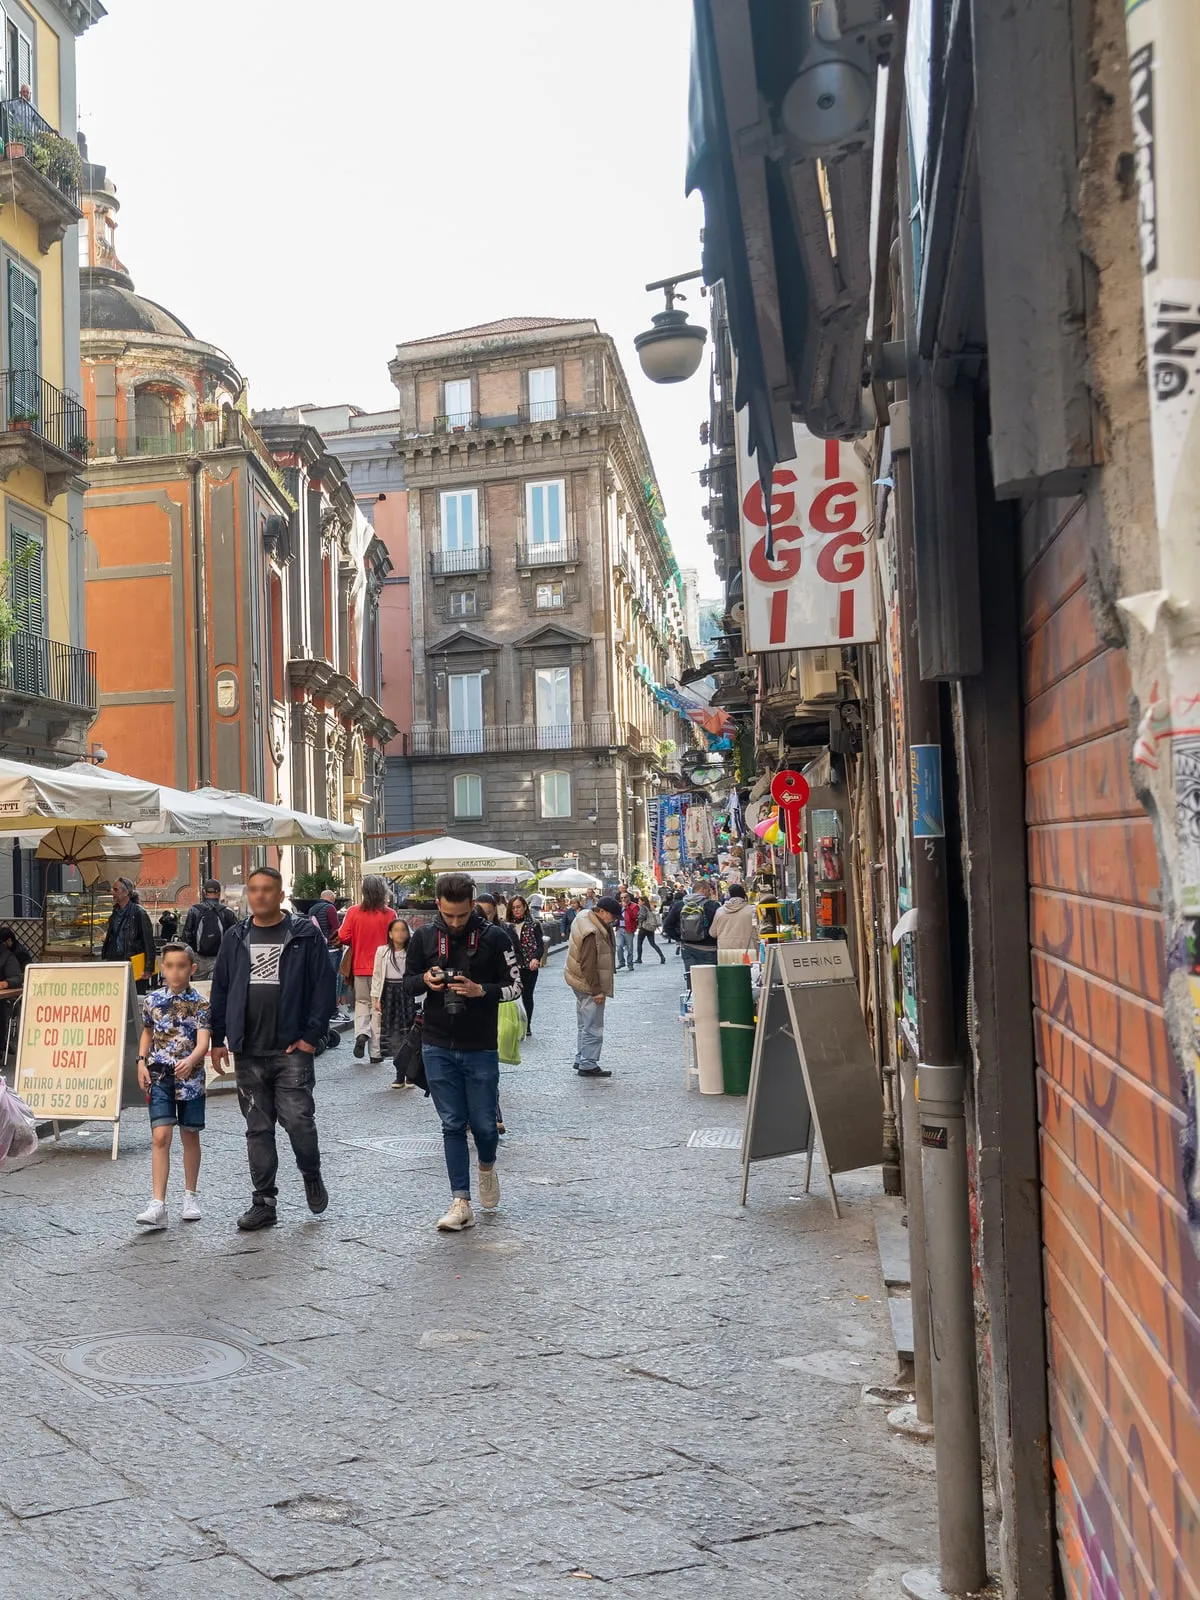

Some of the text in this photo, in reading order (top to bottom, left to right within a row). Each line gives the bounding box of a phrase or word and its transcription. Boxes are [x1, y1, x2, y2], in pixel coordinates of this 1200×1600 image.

[379, 860, 497, 872] PASTICCERIA CARRATURO
[792, 955, 842, 968] BERING
[33, 982, 120, 997] TATTOO RECORDS
[36, 1004, 111, 1023] COMPRIAMO
[27, 1028, 117, 1047] LP CD DVD LIBRI
[52, 1050, 87, 1068] USATI
[24, 1076, 113, 1090] RITIRO A DOMICILIO
[26, 1093, 108, 1109] 081 552 09 73
